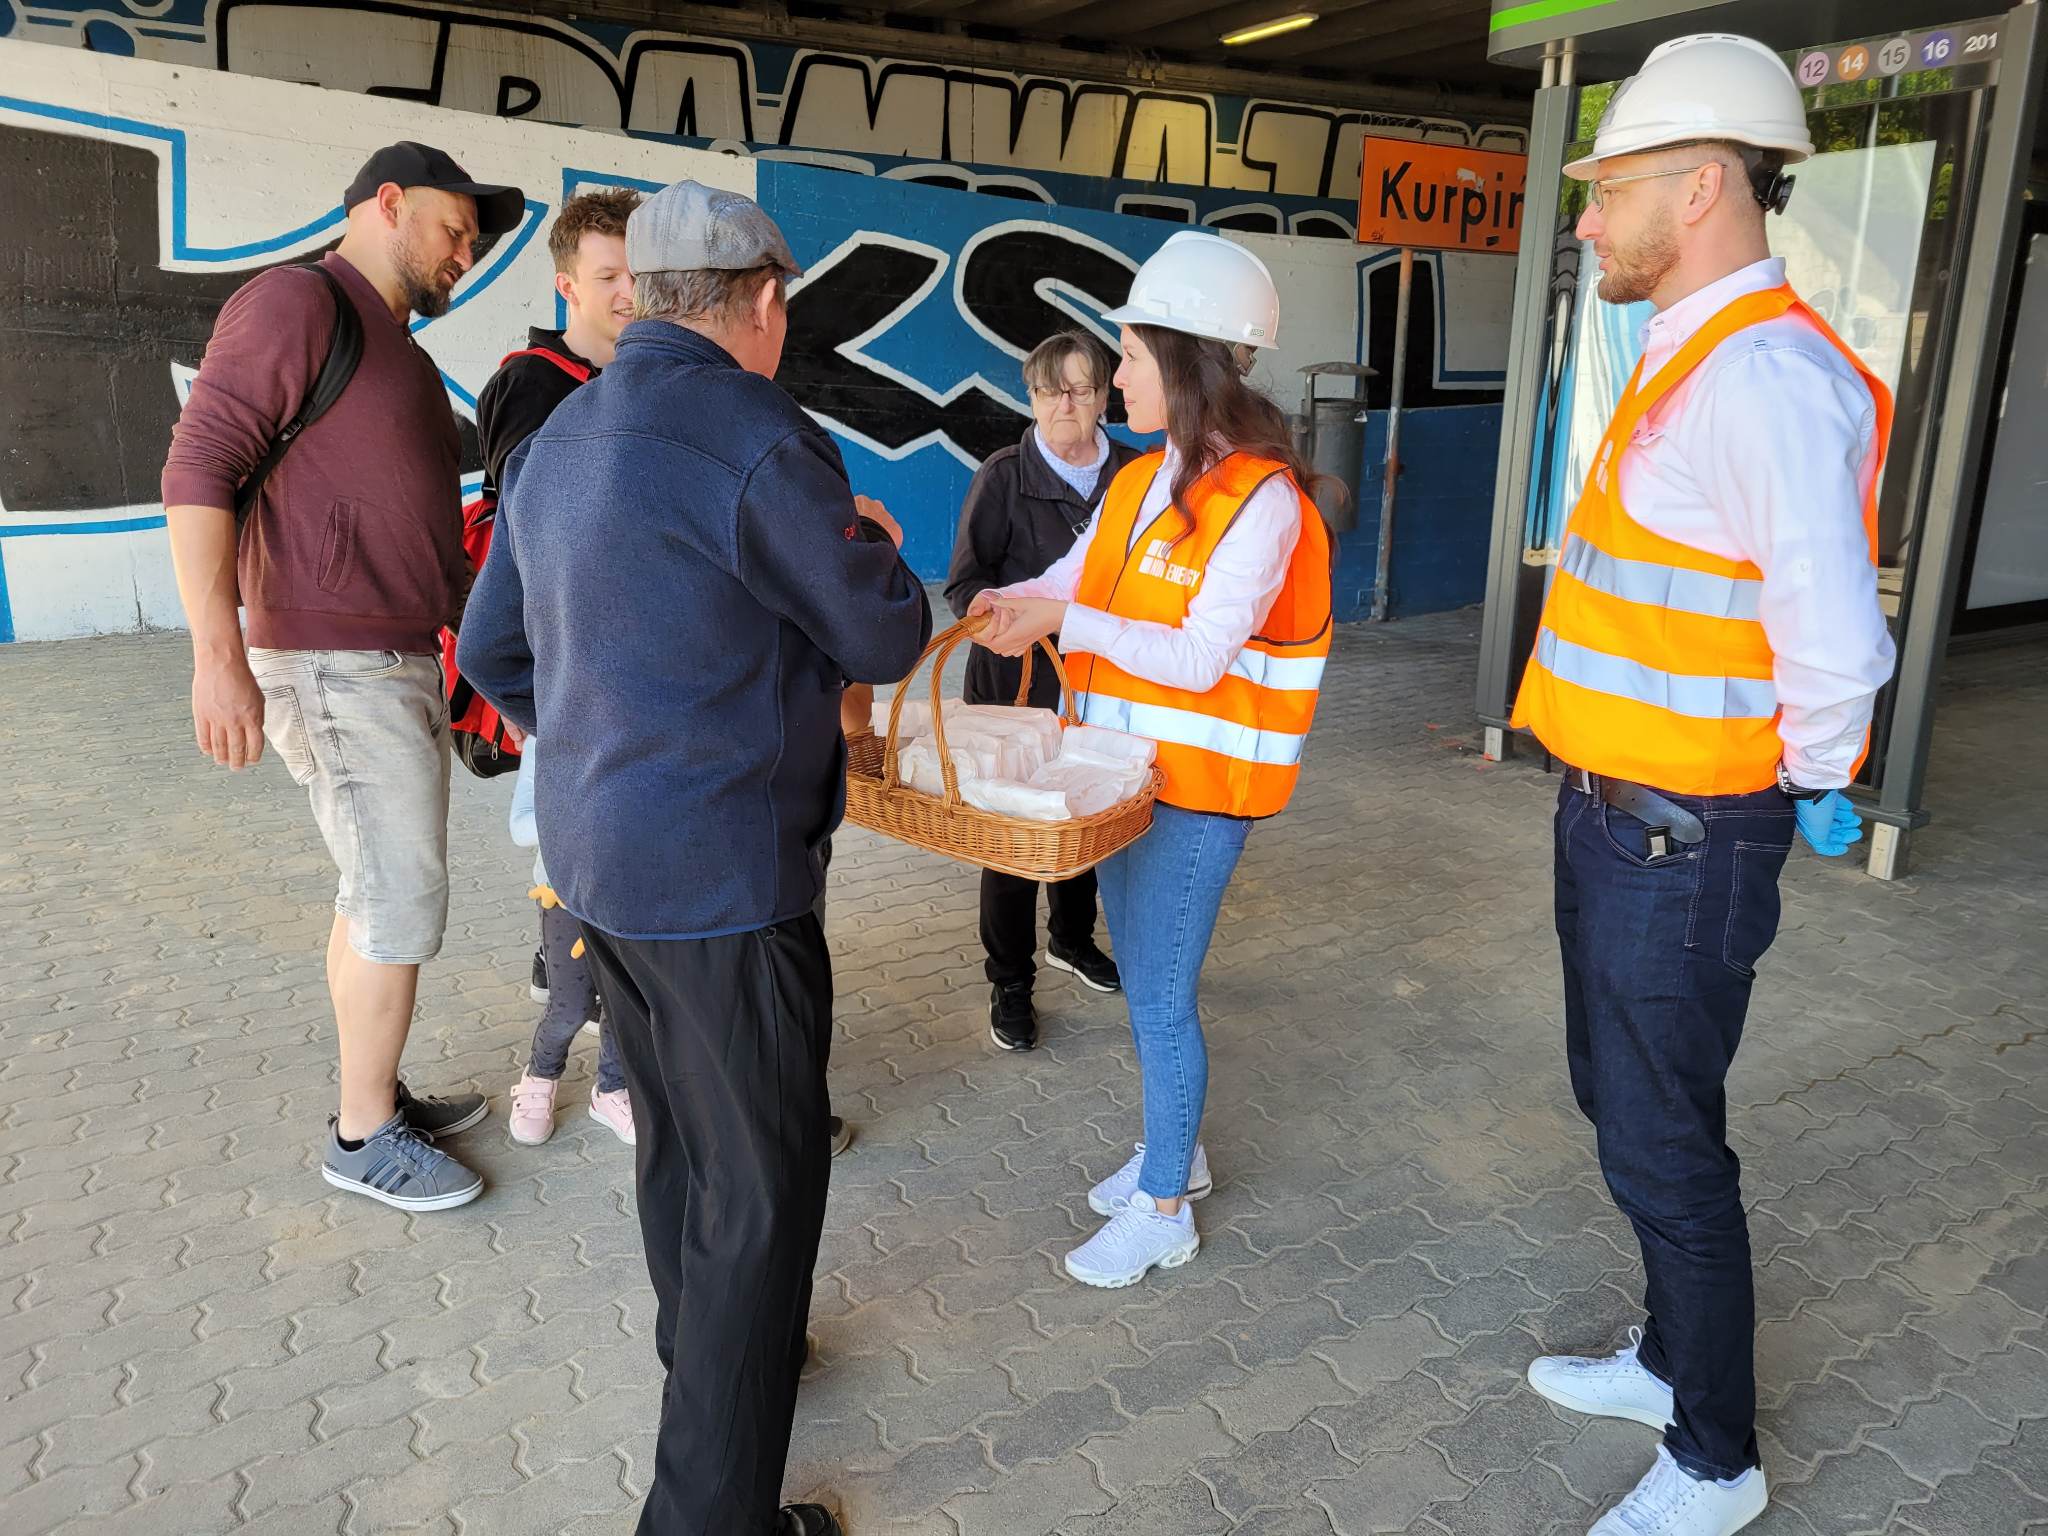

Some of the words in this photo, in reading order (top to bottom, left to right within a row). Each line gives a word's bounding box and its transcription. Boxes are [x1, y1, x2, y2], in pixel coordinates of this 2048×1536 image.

[1803, 58, 1825, 78] 12
[1841, 52, 1865, 73] 14
[1882, 45, 1906, 66] 15
[1922, 38, 1950, 61] 16
[1962, 31, 1998, 54] 201
